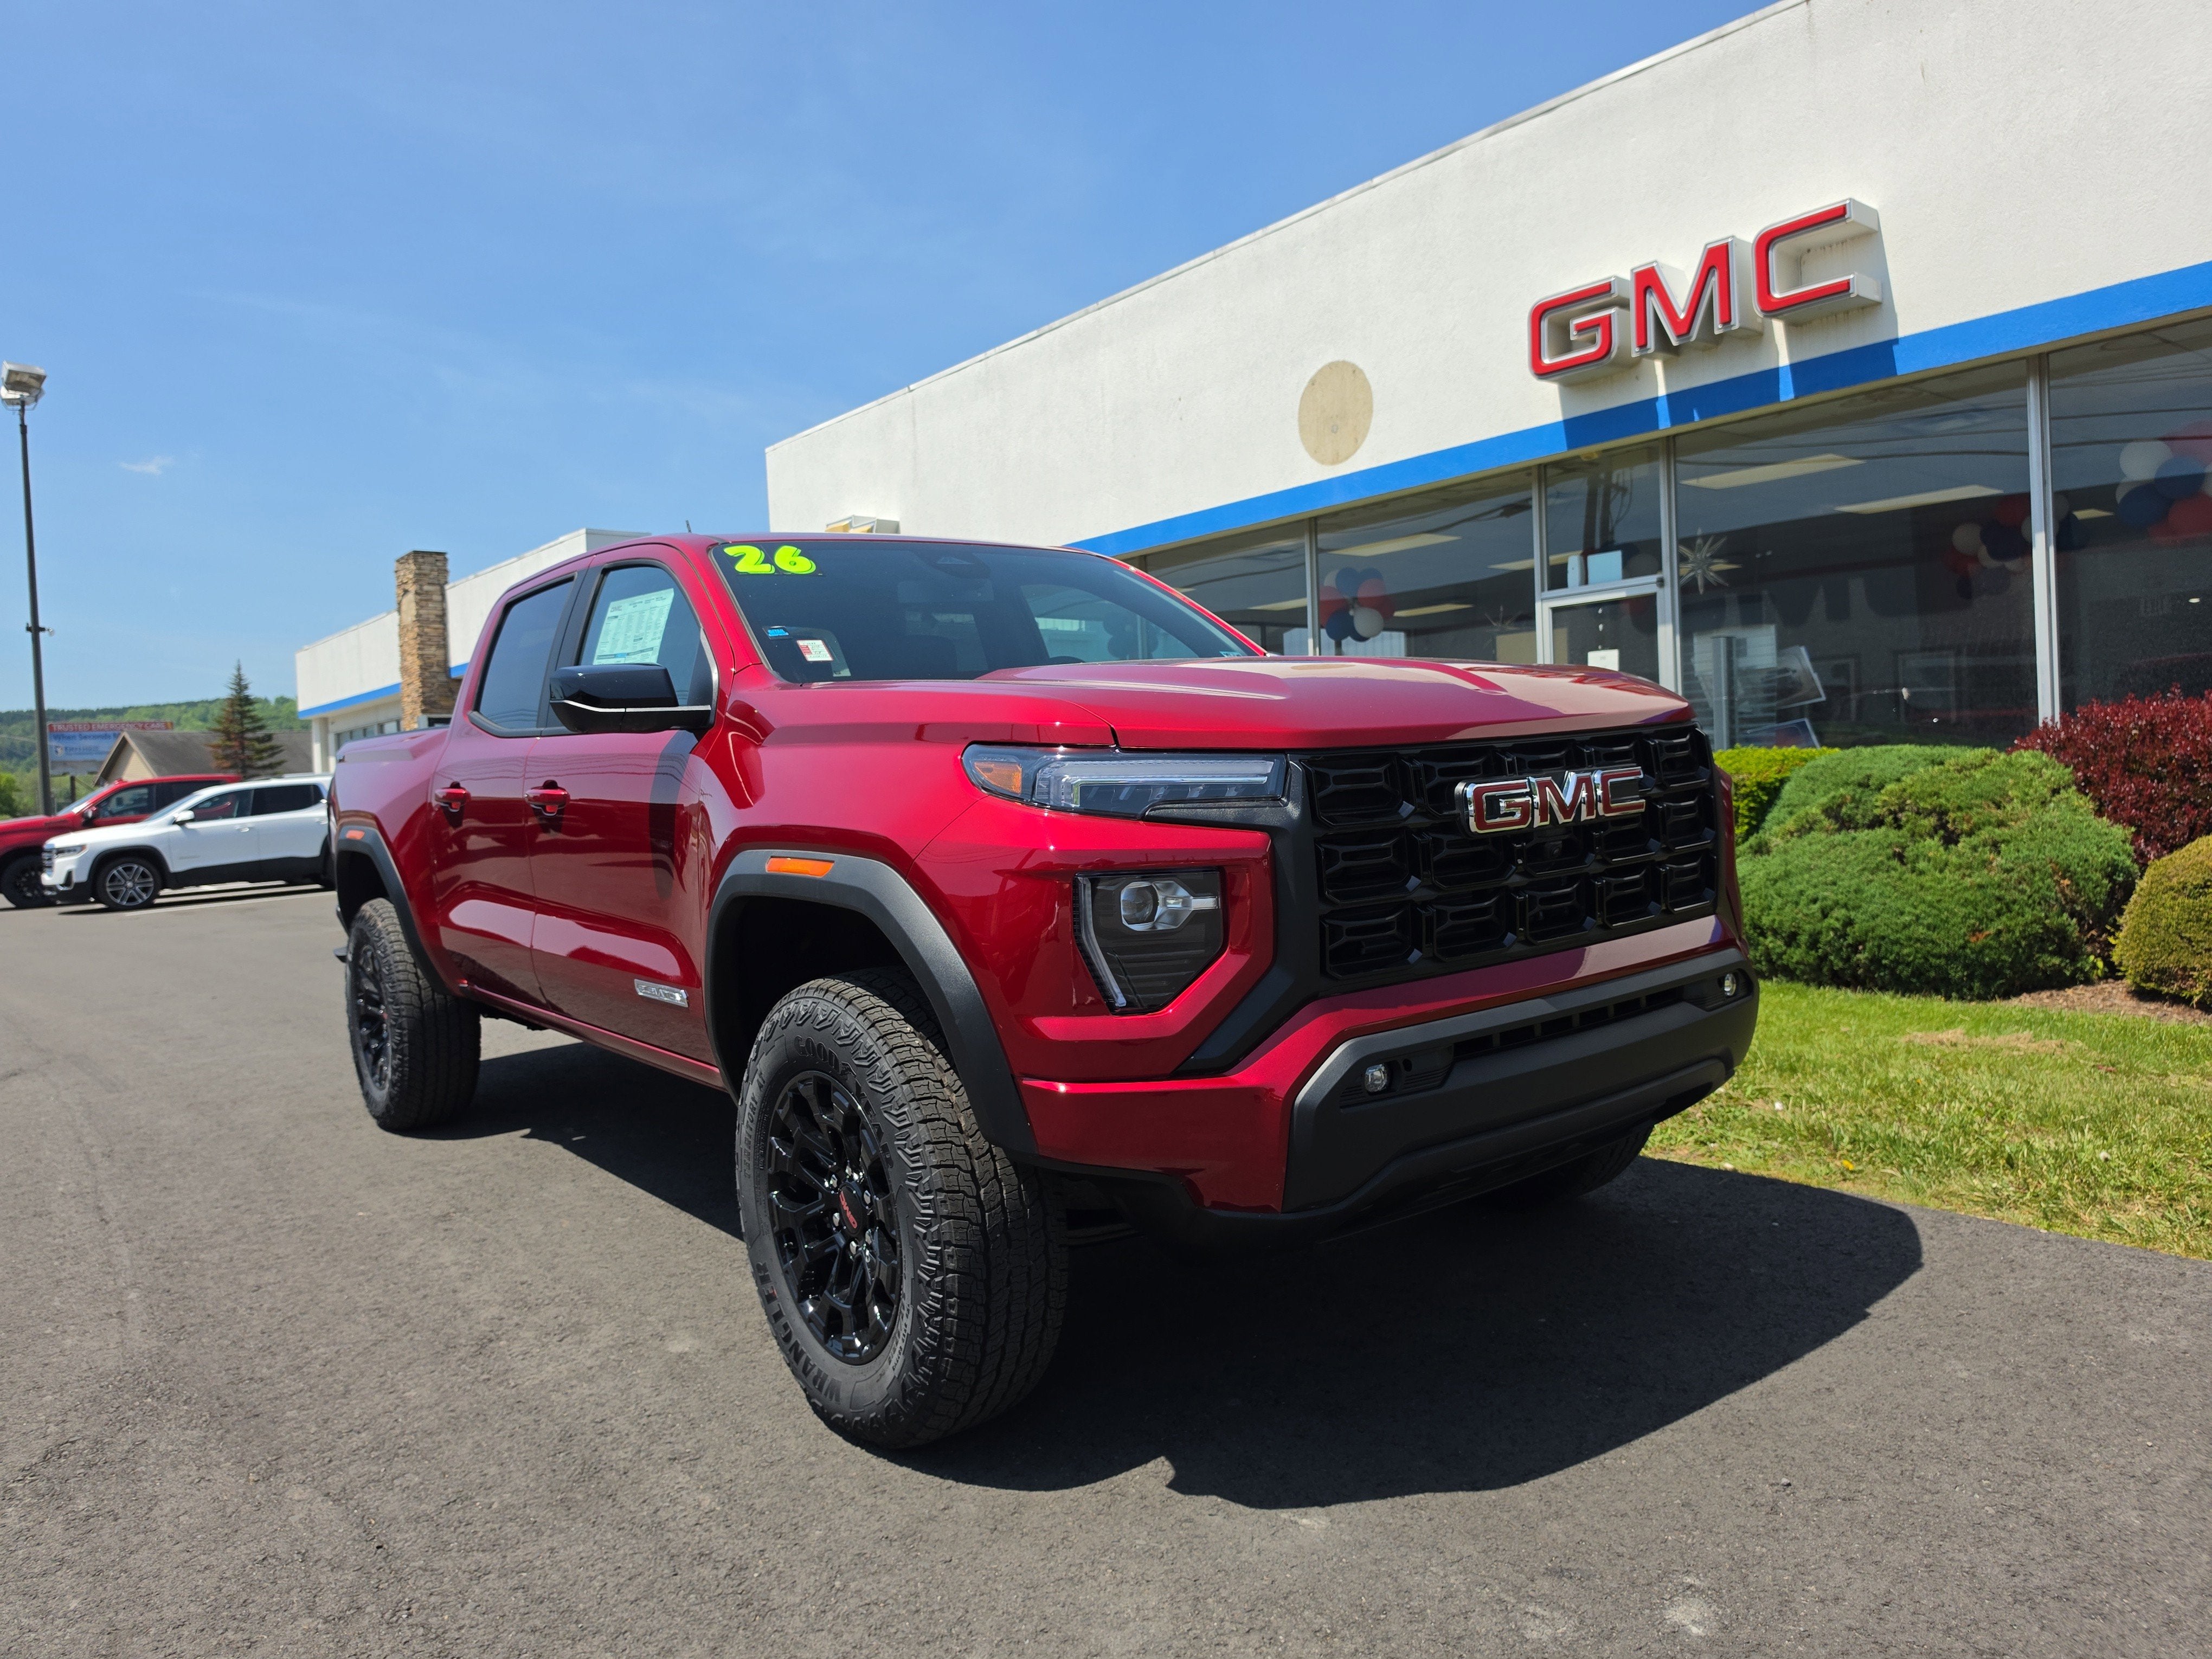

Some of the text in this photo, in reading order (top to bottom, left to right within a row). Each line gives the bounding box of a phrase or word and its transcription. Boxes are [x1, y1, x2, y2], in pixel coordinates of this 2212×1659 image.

[1528, 198, 1860, 381] GMC
[724, 545, 817, 574] 26
[53, 723, 90, 731] TRUSTED
[92, 723, 143, 731] EMERGENCY
[1464, 767, 1646, 834] GMC
[744, 1092, 758, 1179] TERRITORY
[757, 1071, 766, 1091] AT
[839, 1191, 858, 1229] GMC
[756, 1261, 841, 1403] WRANGLER
